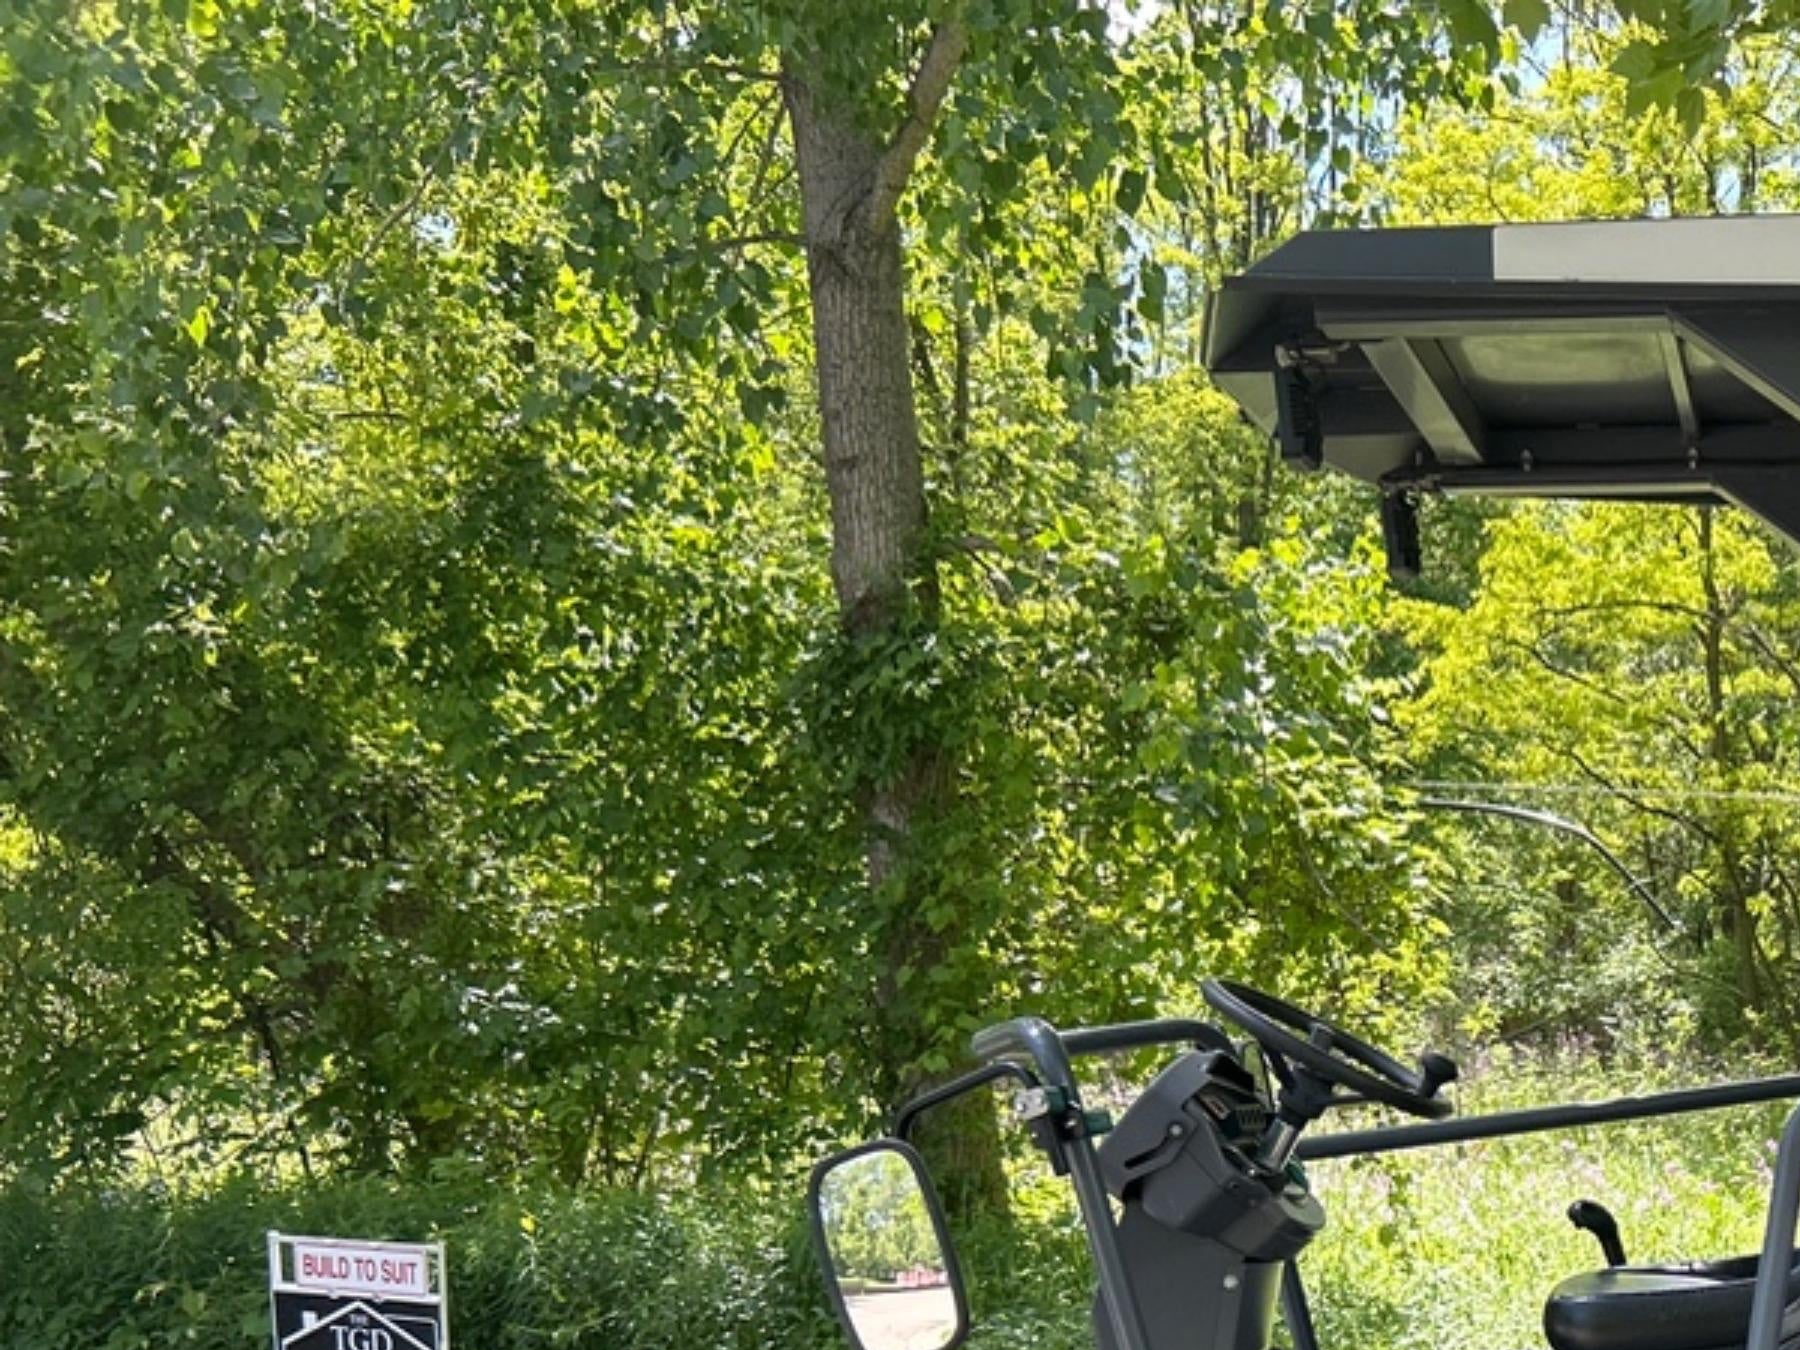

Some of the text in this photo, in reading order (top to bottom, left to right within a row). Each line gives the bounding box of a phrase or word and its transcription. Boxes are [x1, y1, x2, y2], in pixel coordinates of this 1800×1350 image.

[303, 1253, 417, 1284] BUILD TO SUIT
